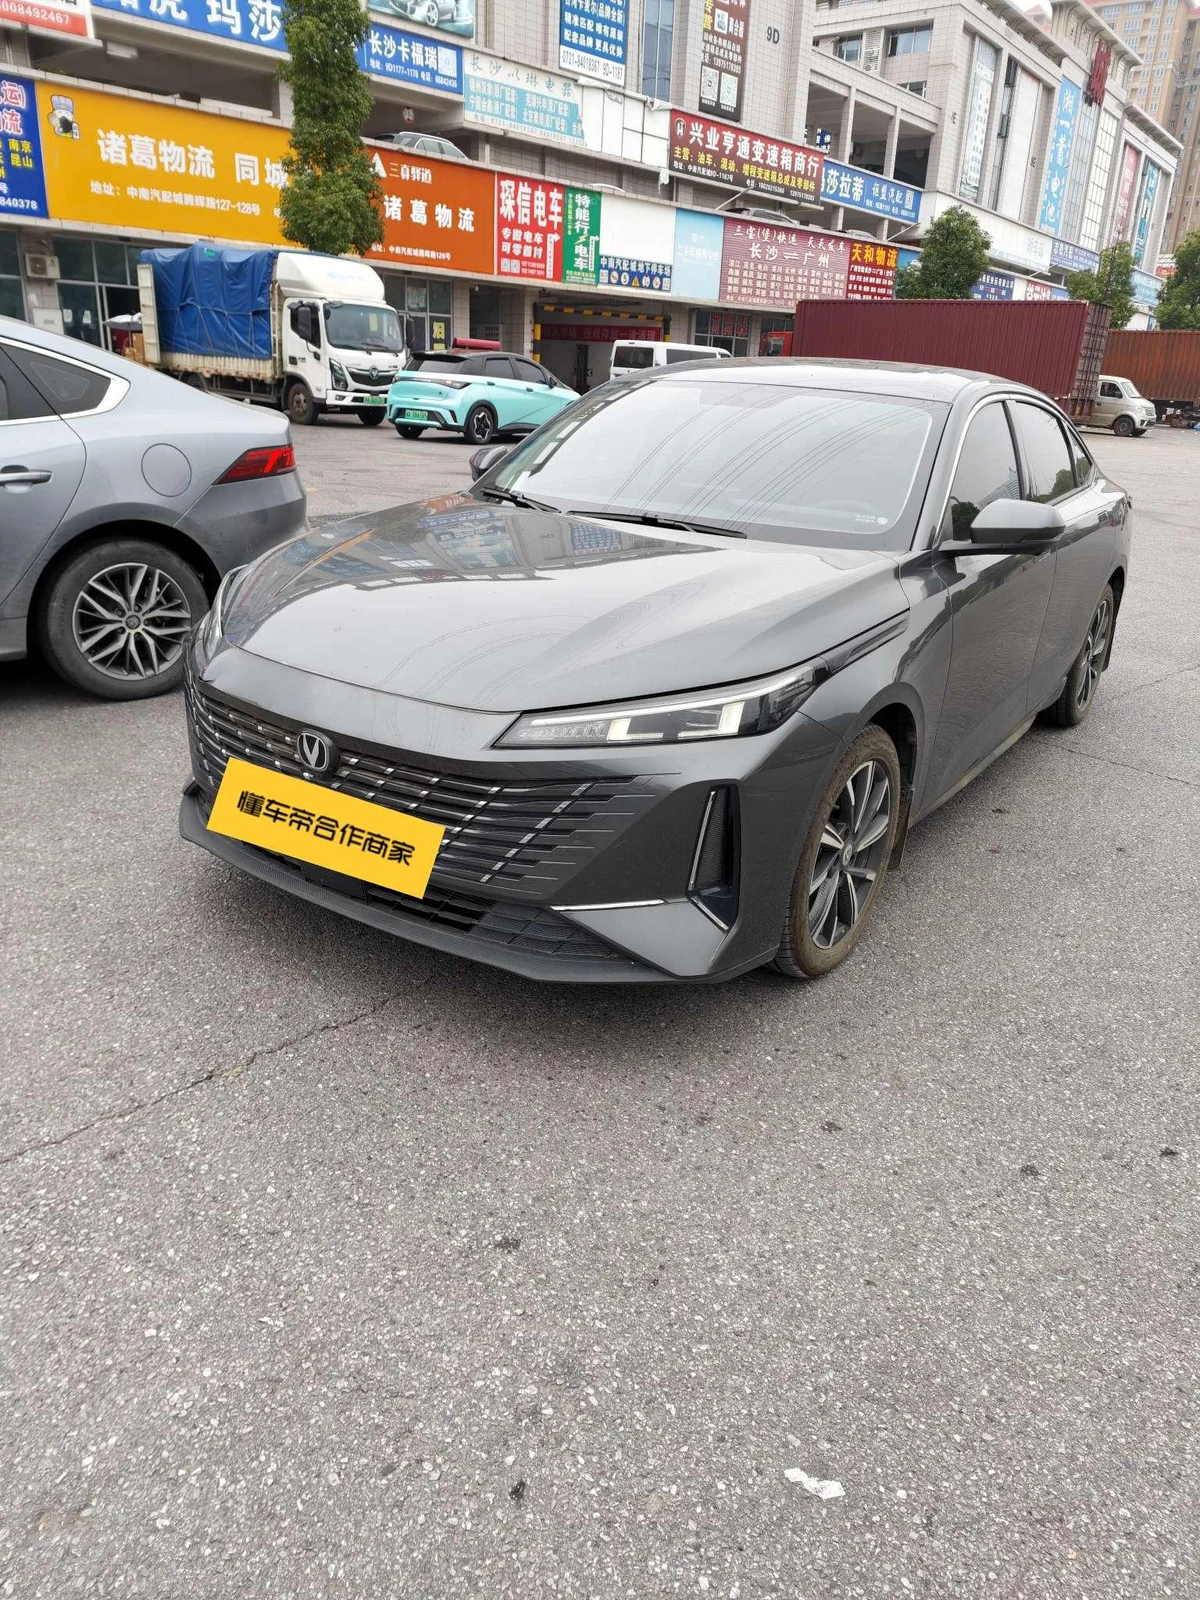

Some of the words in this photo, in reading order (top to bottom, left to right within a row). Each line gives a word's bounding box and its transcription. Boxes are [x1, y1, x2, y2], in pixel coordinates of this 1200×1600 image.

[766, 26, 780, 45] 9D
[369, 29, 437, 71] 长沙卡福瑞
[8, 138, 32, 153] 南京
[96, 128, 216, 179] 诸葛物流
[689, 121, 820, 179] 兴业亨通变速箱商行
[10, 153, 33, 168] 昆山
[383, 194, 475, 233] 诸葛物流
[501, 241, 543, 259] 可零首付
[573, 244, 589, 271] 电车
[749, 242, 779, 261] 长沙
[802, 251, 831, 269] 广州
[851, 242, 898, 268] 天和物流
[600, 255, 672, 277] 中南汽配城地下停车场
